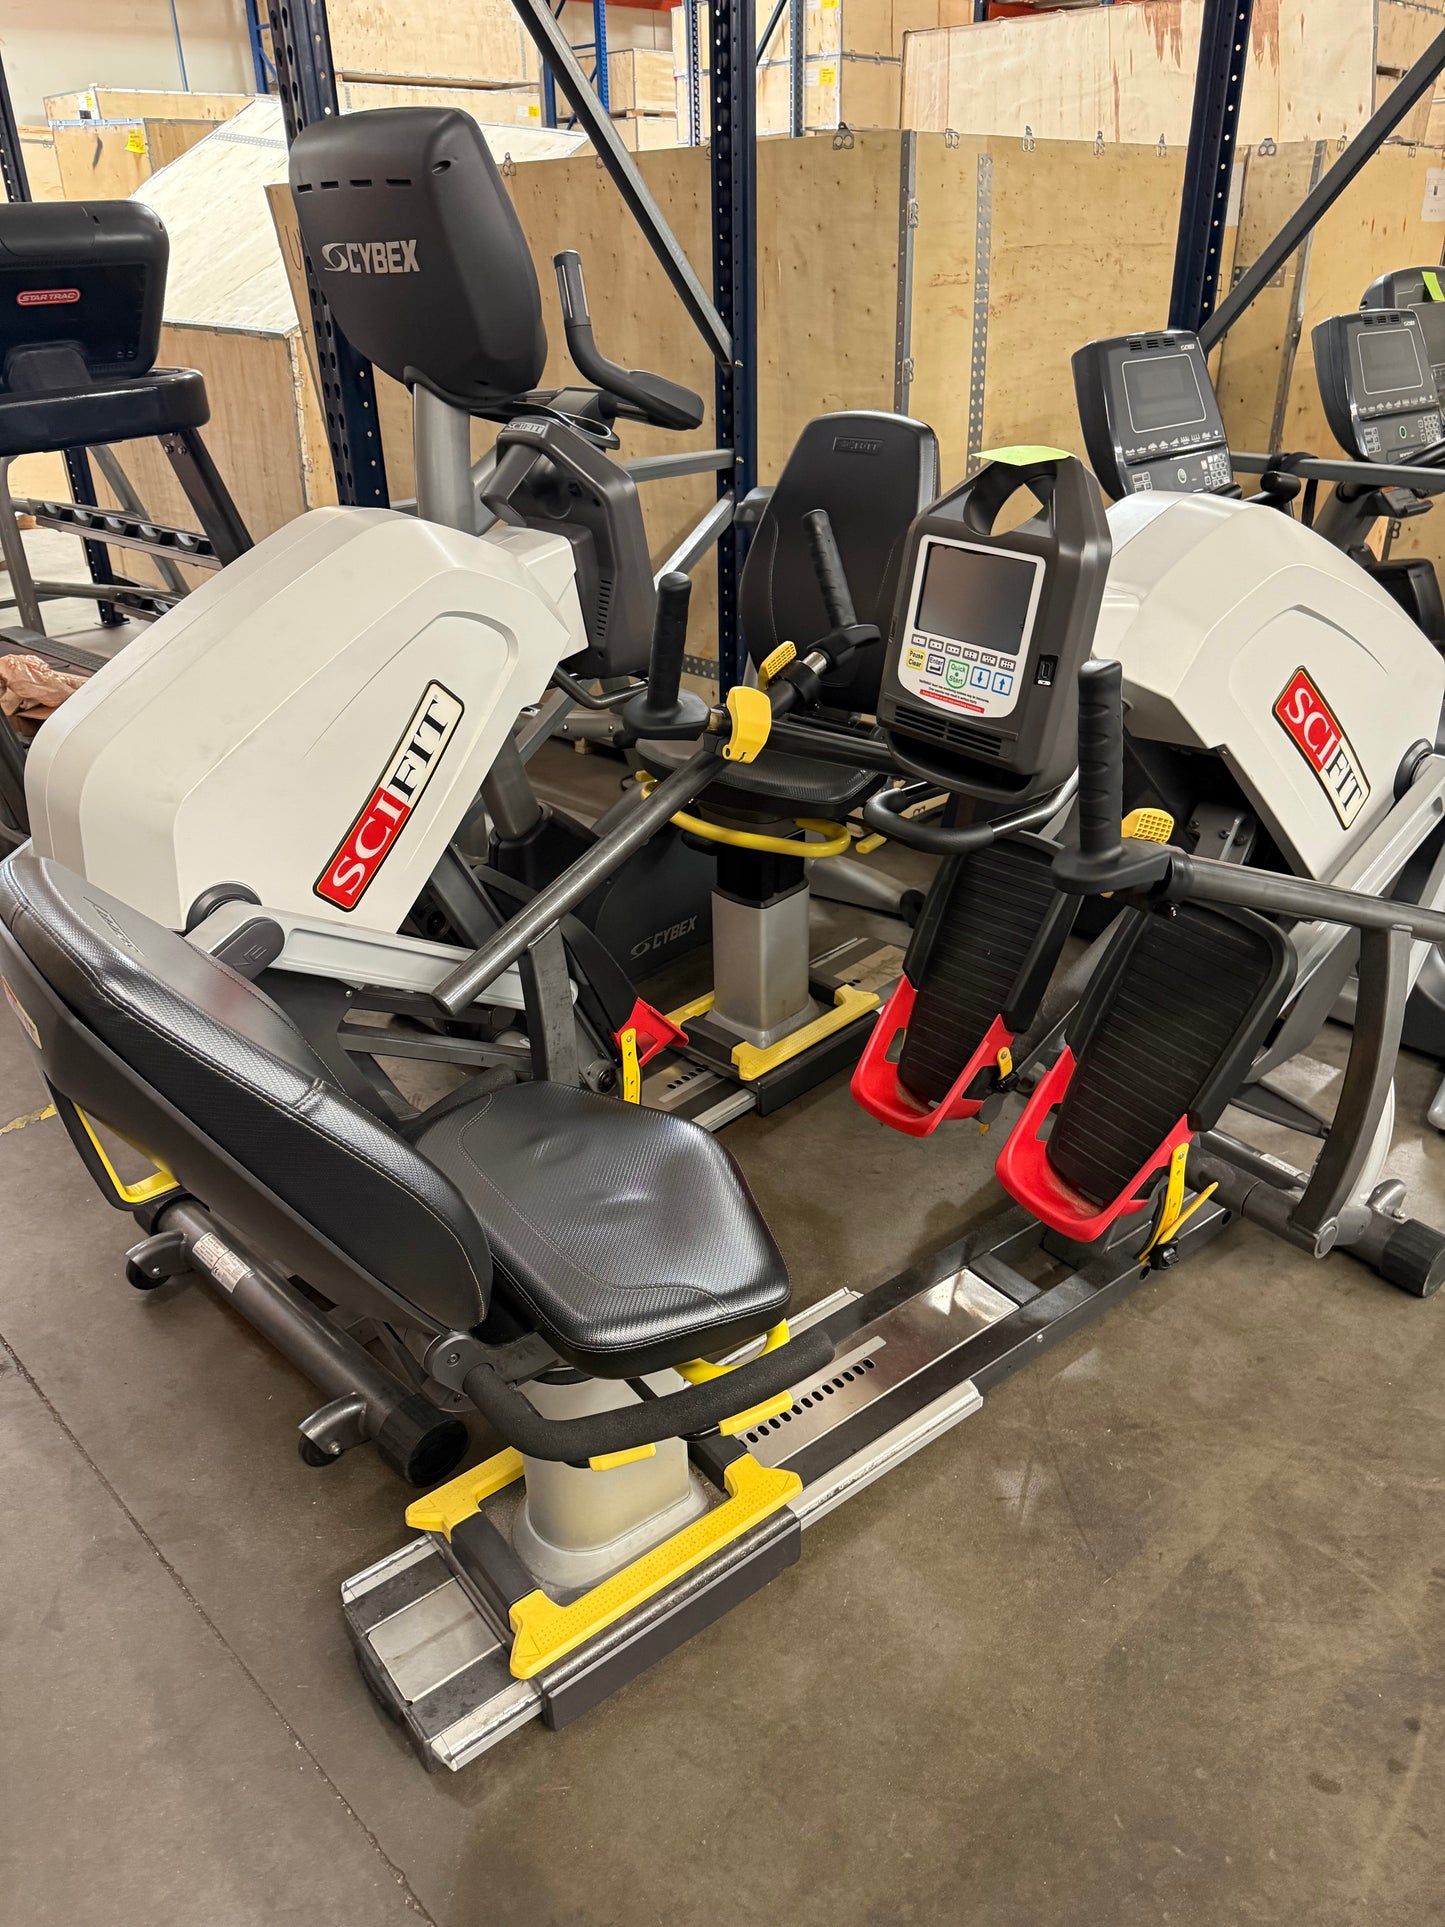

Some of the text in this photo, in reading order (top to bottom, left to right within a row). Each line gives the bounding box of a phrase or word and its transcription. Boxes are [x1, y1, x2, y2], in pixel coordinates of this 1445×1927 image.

[345, 239, 420, 274] CYBEX
[22, 292, 77, 302] STAR TRAC
[909, 650, 924, 660] Pause
[908, 659, 922, 668] Clear
[929, 657, 943, 666] Enter
[951, 663, 966, 673] Quick
[949, 675, 963, 685] Start
[1284, 687, 1363, 811] SCIFIT
[332, 699, 449, 896] SCIFIT
[652, 914, 698, 950] CYBEX
